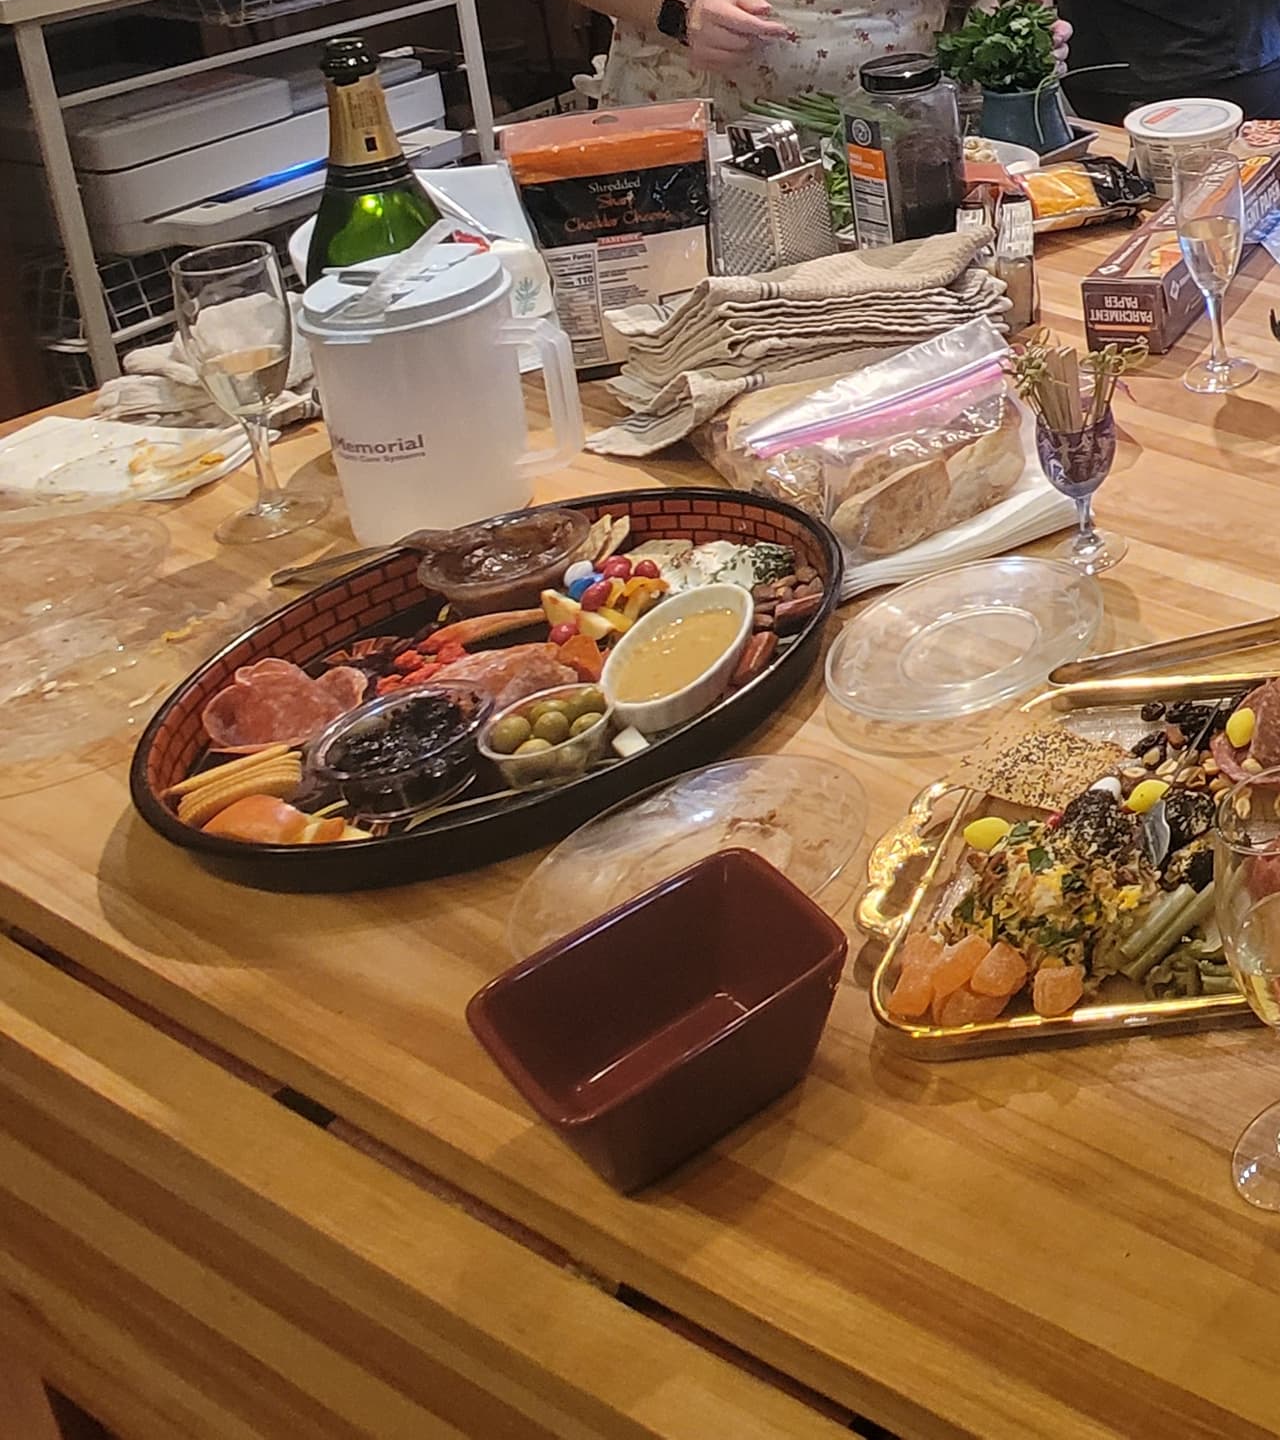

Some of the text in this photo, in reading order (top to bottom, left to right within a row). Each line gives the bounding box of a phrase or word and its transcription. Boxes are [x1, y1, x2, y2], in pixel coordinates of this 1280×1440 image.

[588, 175, 641, 194] Shredded
[1104, 295, 1139, 309] PAPER
[1090, 308, 1153, 323] PARCHMENT
